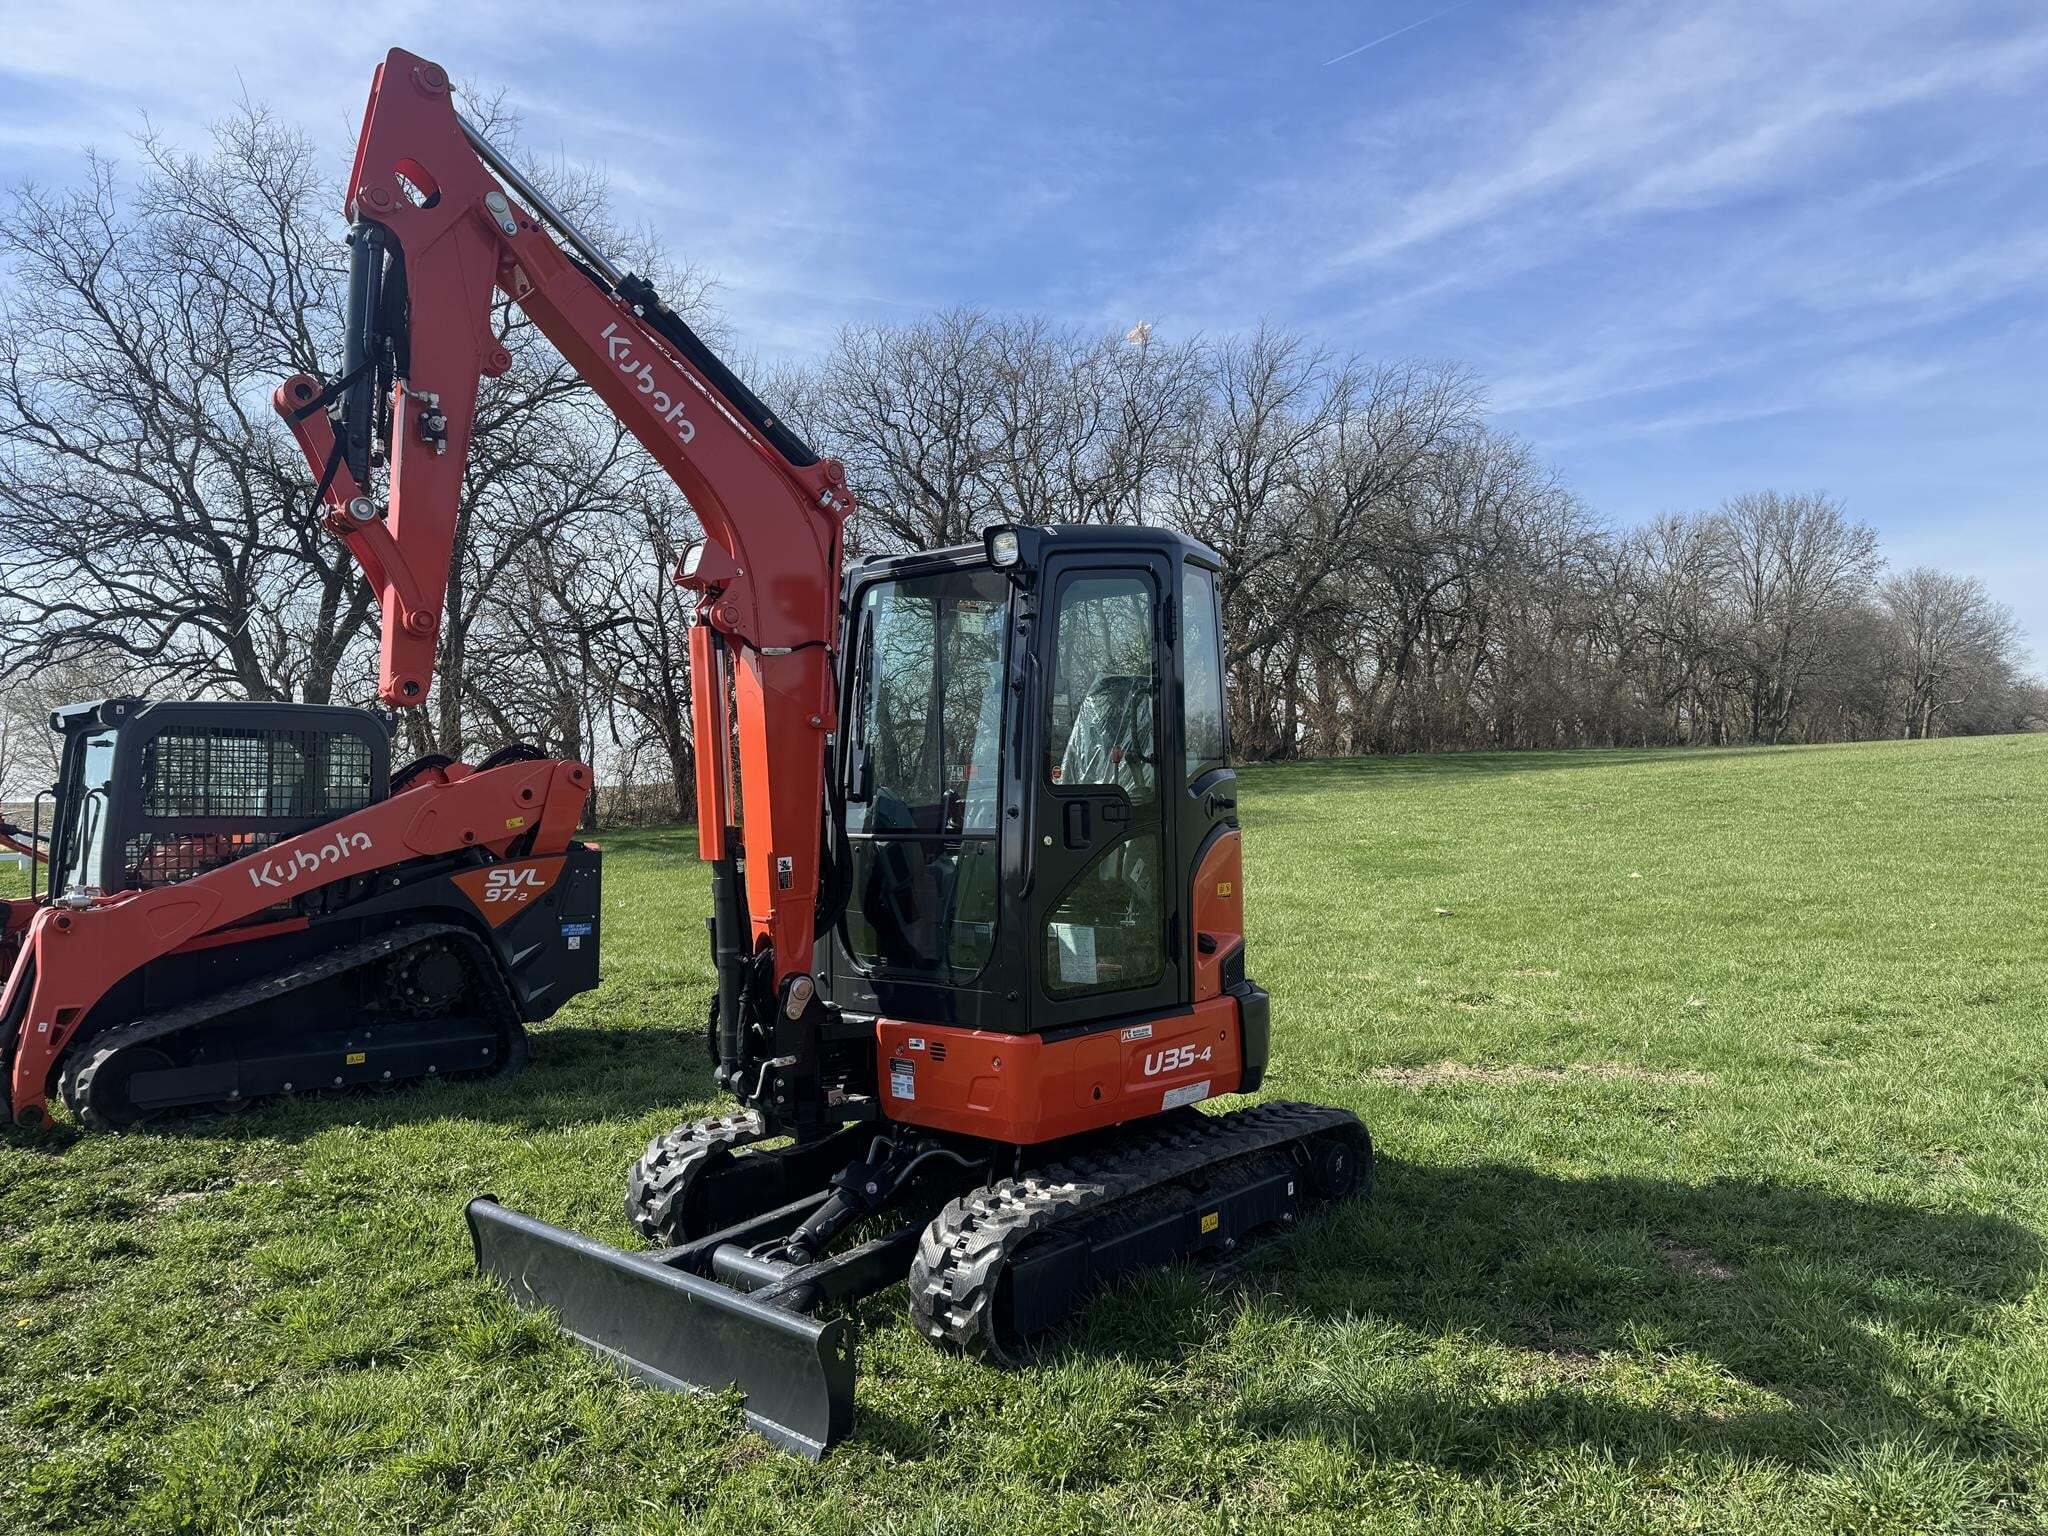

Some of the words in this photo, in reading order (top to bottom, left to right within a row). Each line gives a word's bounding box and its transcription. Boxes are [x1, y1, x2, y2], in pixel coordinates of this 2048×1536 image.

[600, 322, 696, 444] Kubota
[248, 832, 373, 888] Kubota
[484, 868, 546, 887] SVL
[484, 888, 528, 902] 97-2
[1144, 1044, 1212, 1076] U35-4
